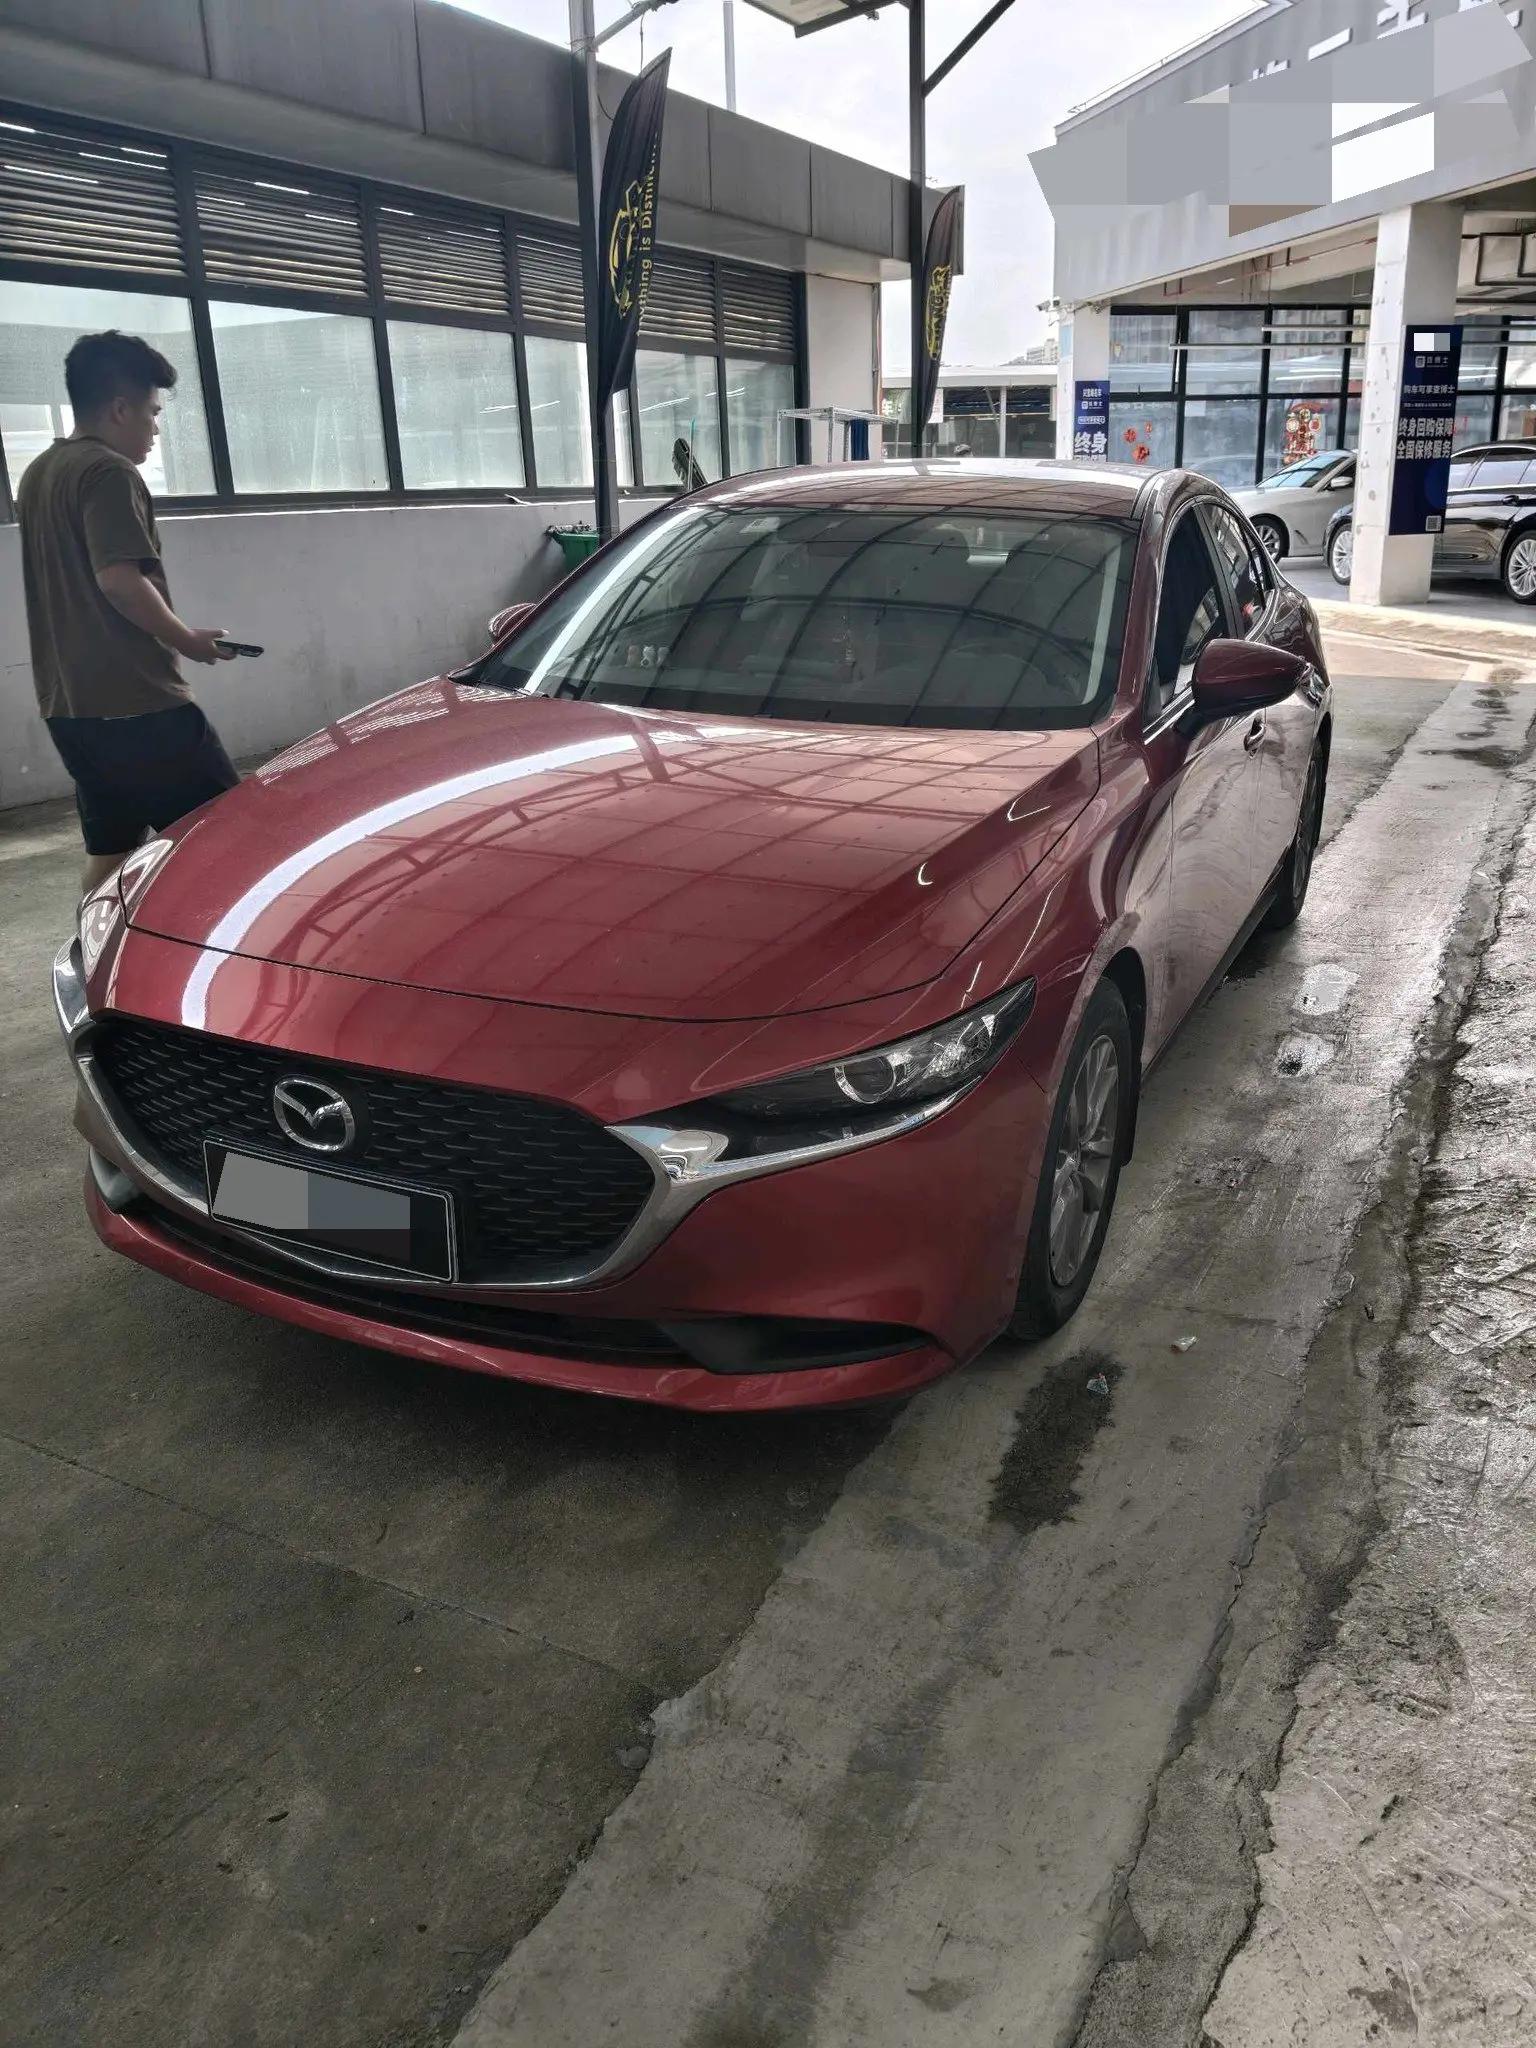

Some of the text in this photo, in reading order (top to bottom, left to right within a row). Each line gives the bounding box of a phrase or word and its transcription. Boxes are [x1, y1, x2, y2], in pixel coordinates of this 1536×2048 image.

[639, 235, 652, 252] is
[1398, 417, 1454, 437] 终身回购保障
[1074, 431, 1107, 454] 终身
[1396, 440, 1451, 460] 全国保修服务
